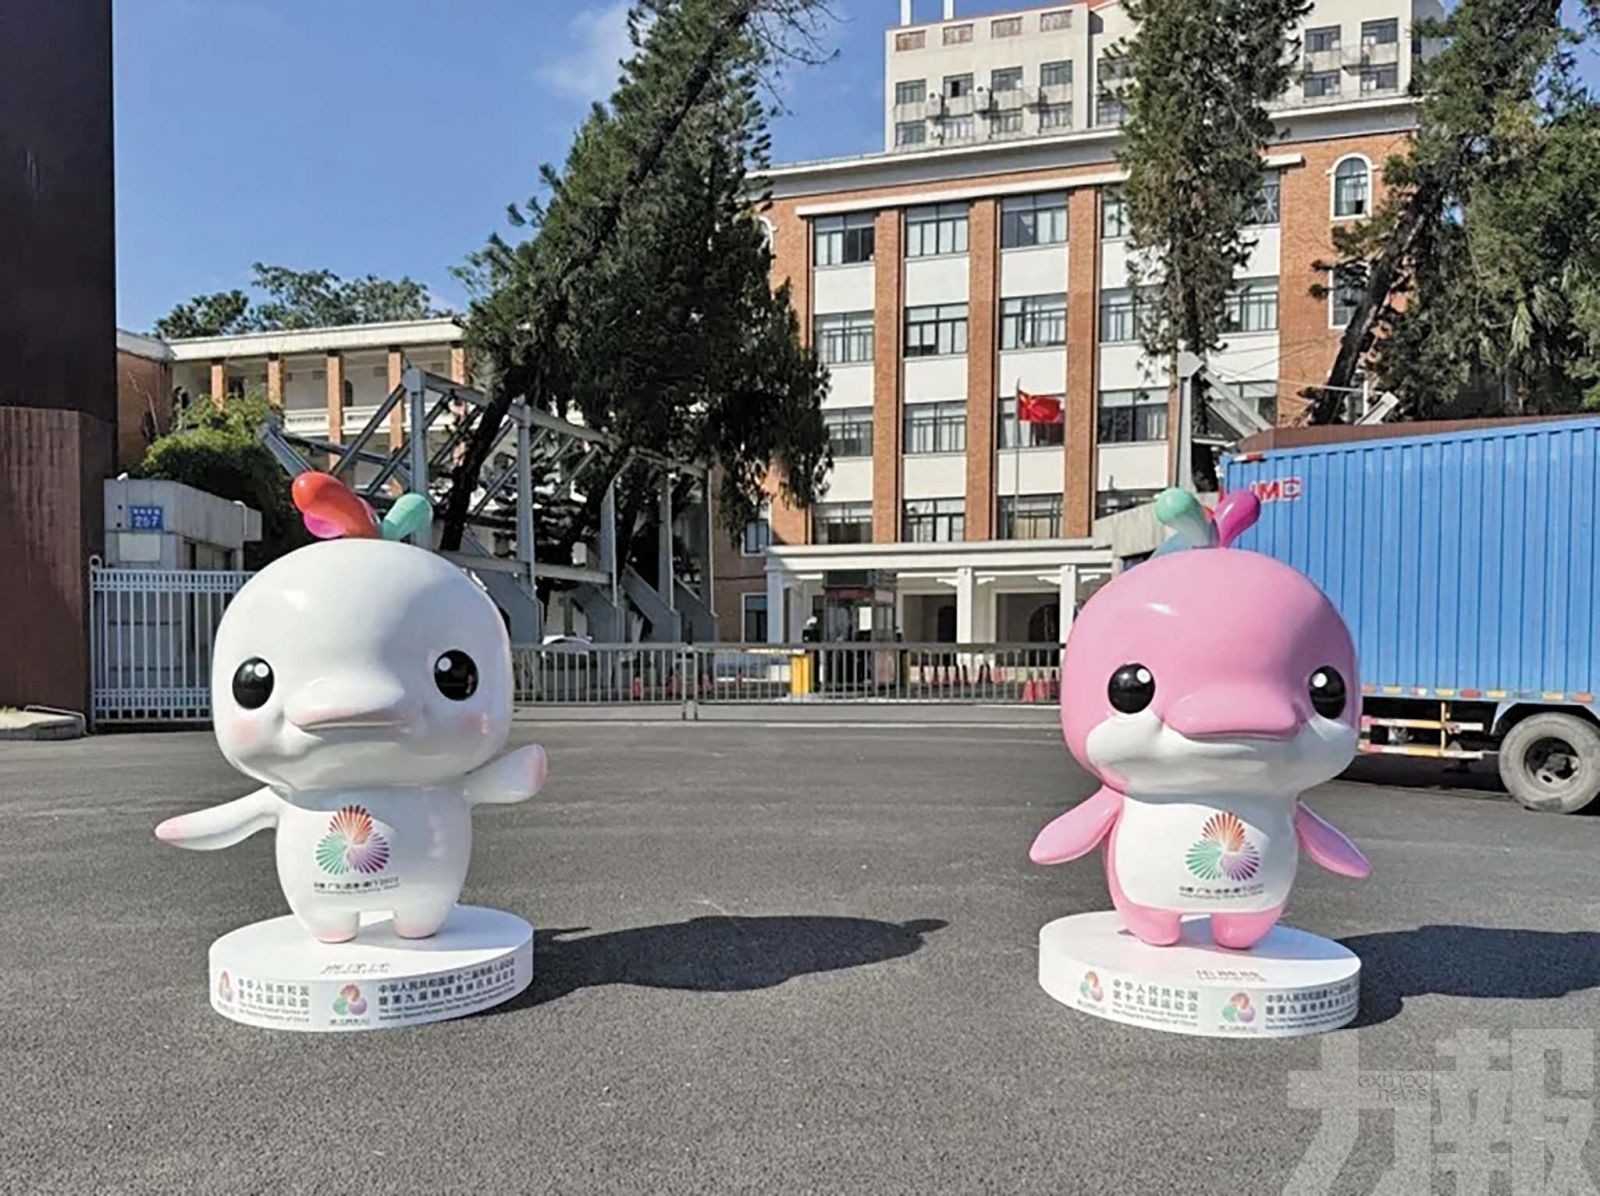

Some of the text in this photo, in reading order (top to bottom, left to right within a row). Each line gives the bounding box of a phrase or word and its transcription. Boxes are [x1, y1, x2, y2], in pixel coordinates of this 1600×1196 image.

[238, 978, 310, 997] 中华人民共和国
[1113, 979, 1199, 1000] 中华人民共和国
[1113, 989, 1198, 1012] 第十五届运动会
